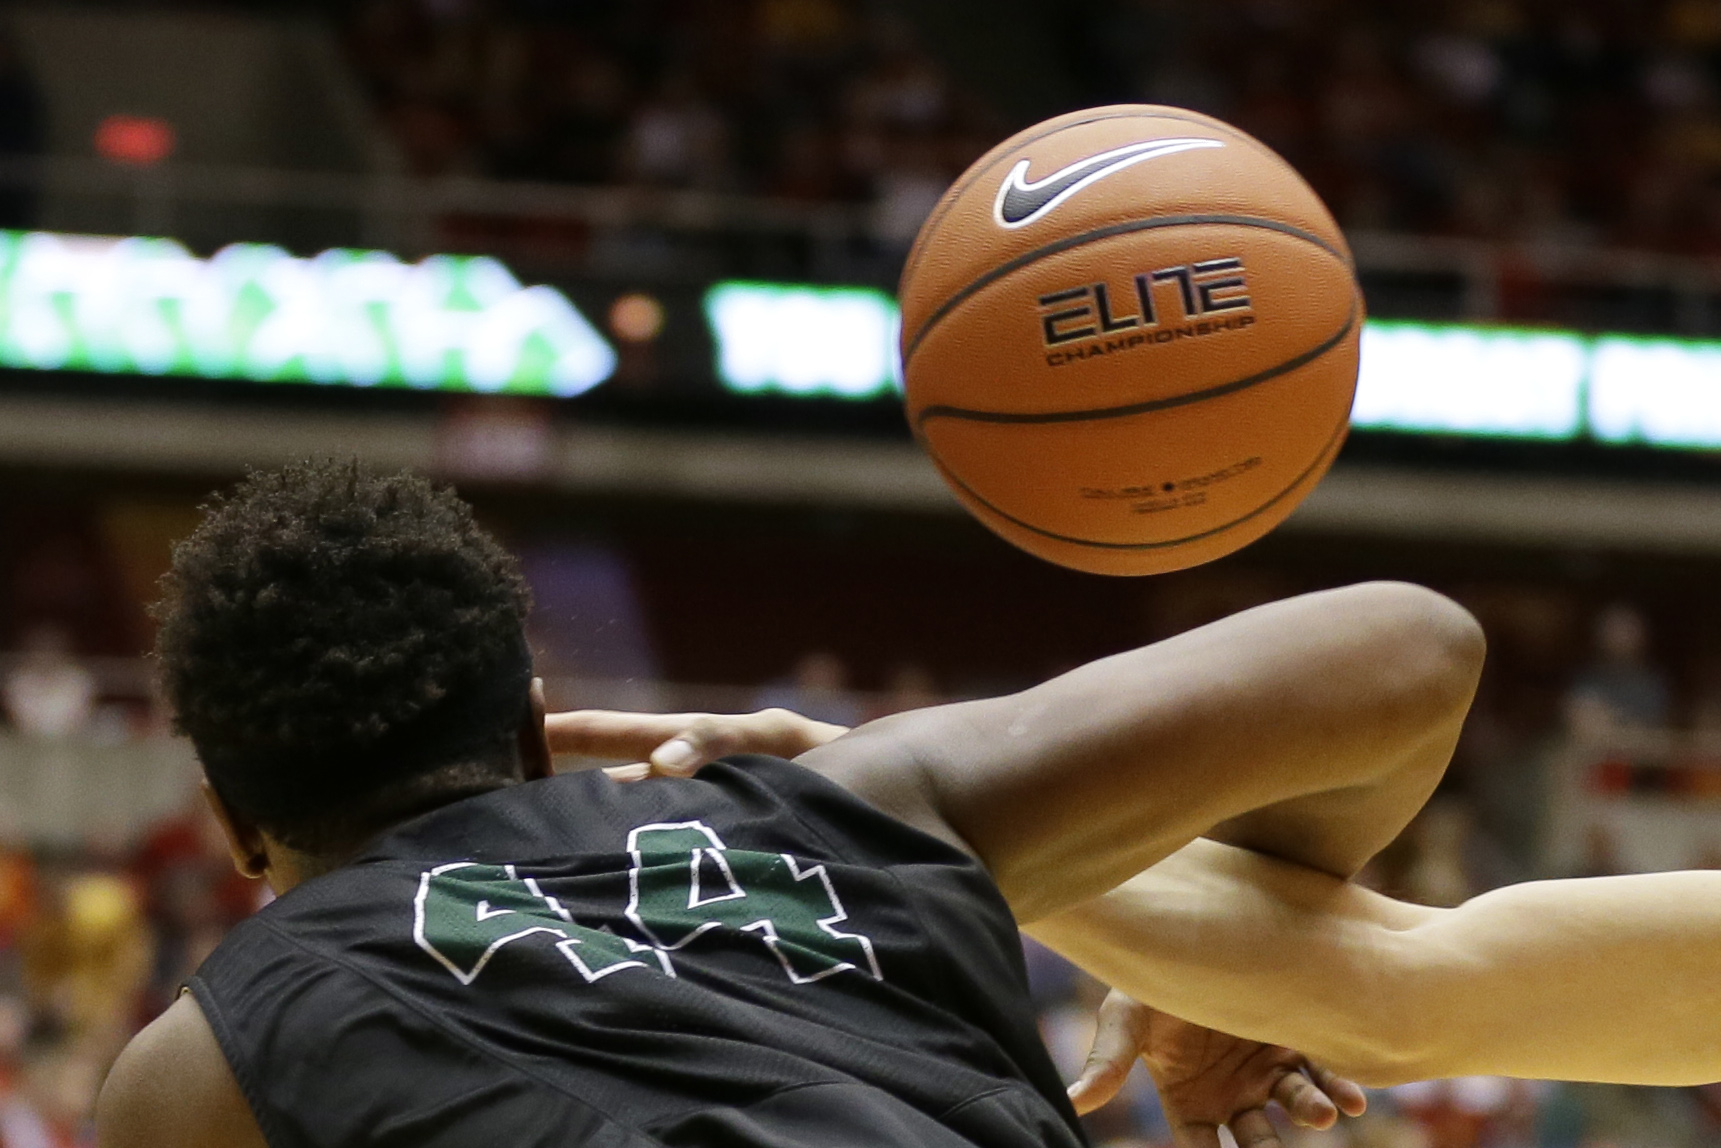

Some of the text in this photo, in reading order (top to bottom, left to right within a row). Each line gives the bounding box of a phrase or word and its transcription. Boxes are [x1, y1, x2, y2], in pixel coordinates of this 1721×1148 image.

[1037, 257, 1252, 348] ELITE
[1046, 315, 1256, 367] CHAMPIONSHIP
[413, 820, 884, 986] 44
